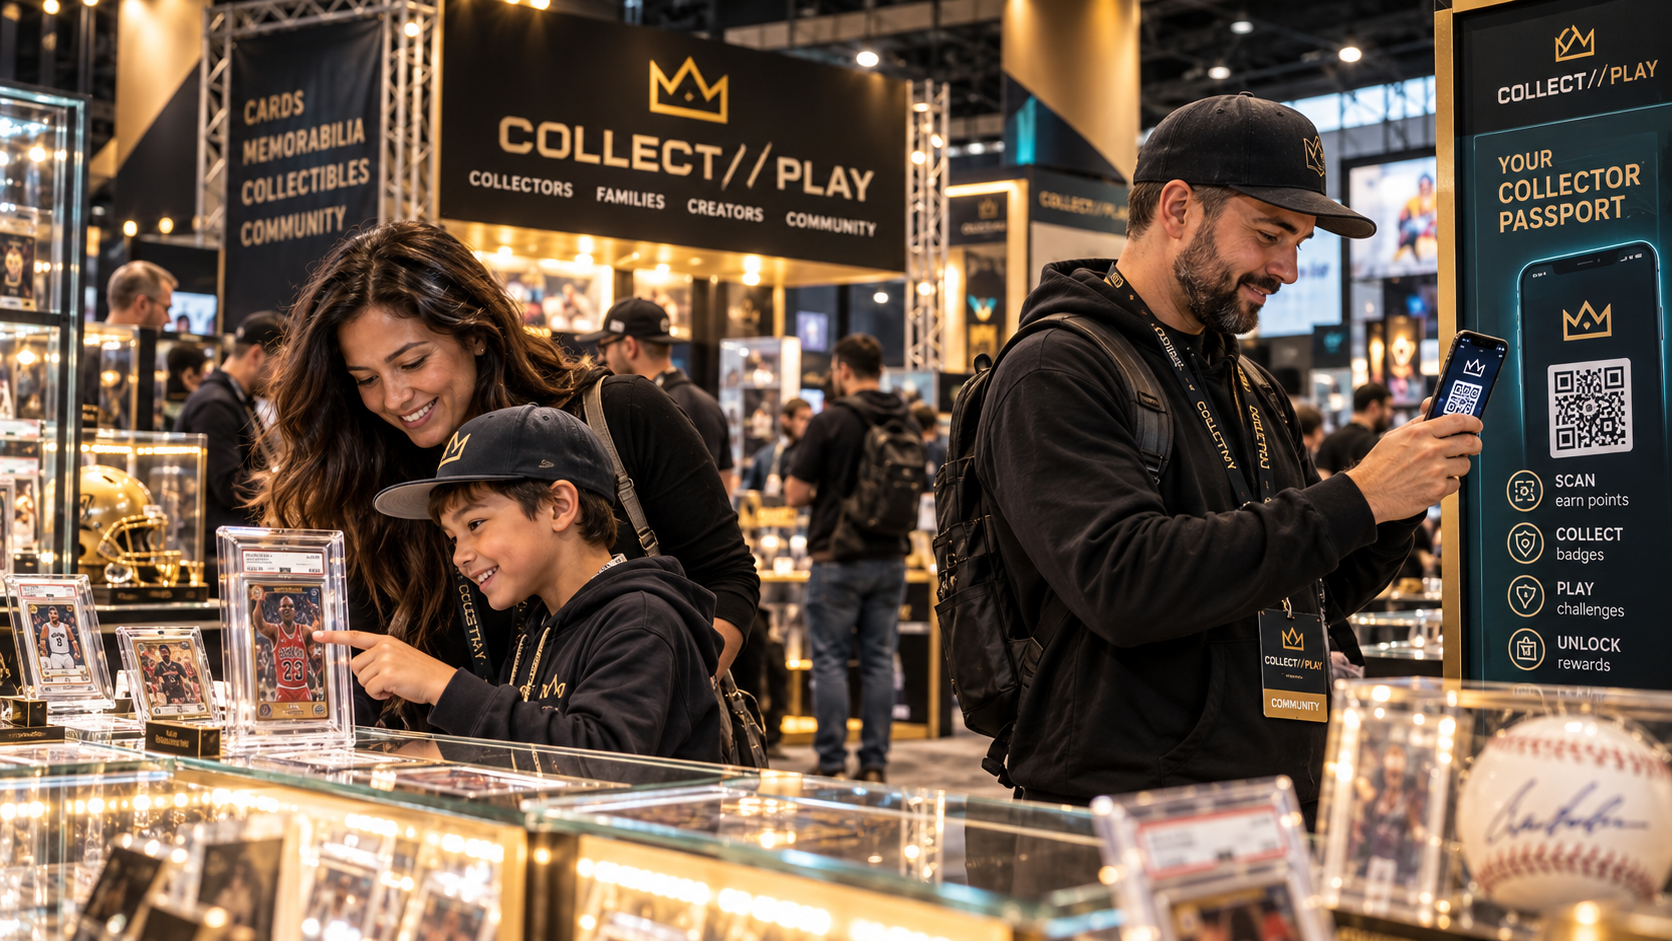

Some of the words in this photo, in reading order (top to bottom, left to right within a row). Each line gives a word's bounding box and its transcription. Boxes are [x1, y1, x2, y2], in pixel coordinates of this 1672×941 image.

[244, 89, 305, 126] CARDS
[242, 117, 366, 166] MEMORABILIA
[1498, 149, 1553, 174] YOUR
[241, 157, 371, 206] COLLECTIBLES
[1498, 163, 1641, 204] COLLECTOR
[469, 170, 574, 198] COLLECTORS
[596, 186, 666, 210] FAMILIES
[687, 198, 764, 222] CREATORS
[785, 211, 877, 237] COMMUNITY
[1499, 195, 1626, 233] PASSPORT
[240, 205, 347, 247] COMMUNITY
[1555, 473, 1596, 488] SCAN
[1555, 496, 1584, 508] earn
[1588, 493, 1630, 510] points
[1556, 527, 1624, 542] COLLECT
[1556, 547, 1605, 564] badges
[1556, 581, 1595, 597] PLAY
[1557, 602, 1625, 620] challenges
[1557, 635, 1621, 653] UNLOCK
[281, 660, 304, 682] 23
[1557, 657, 1611, 672] rewards
[1271, 698, 1320, 711] COMMUNITY
